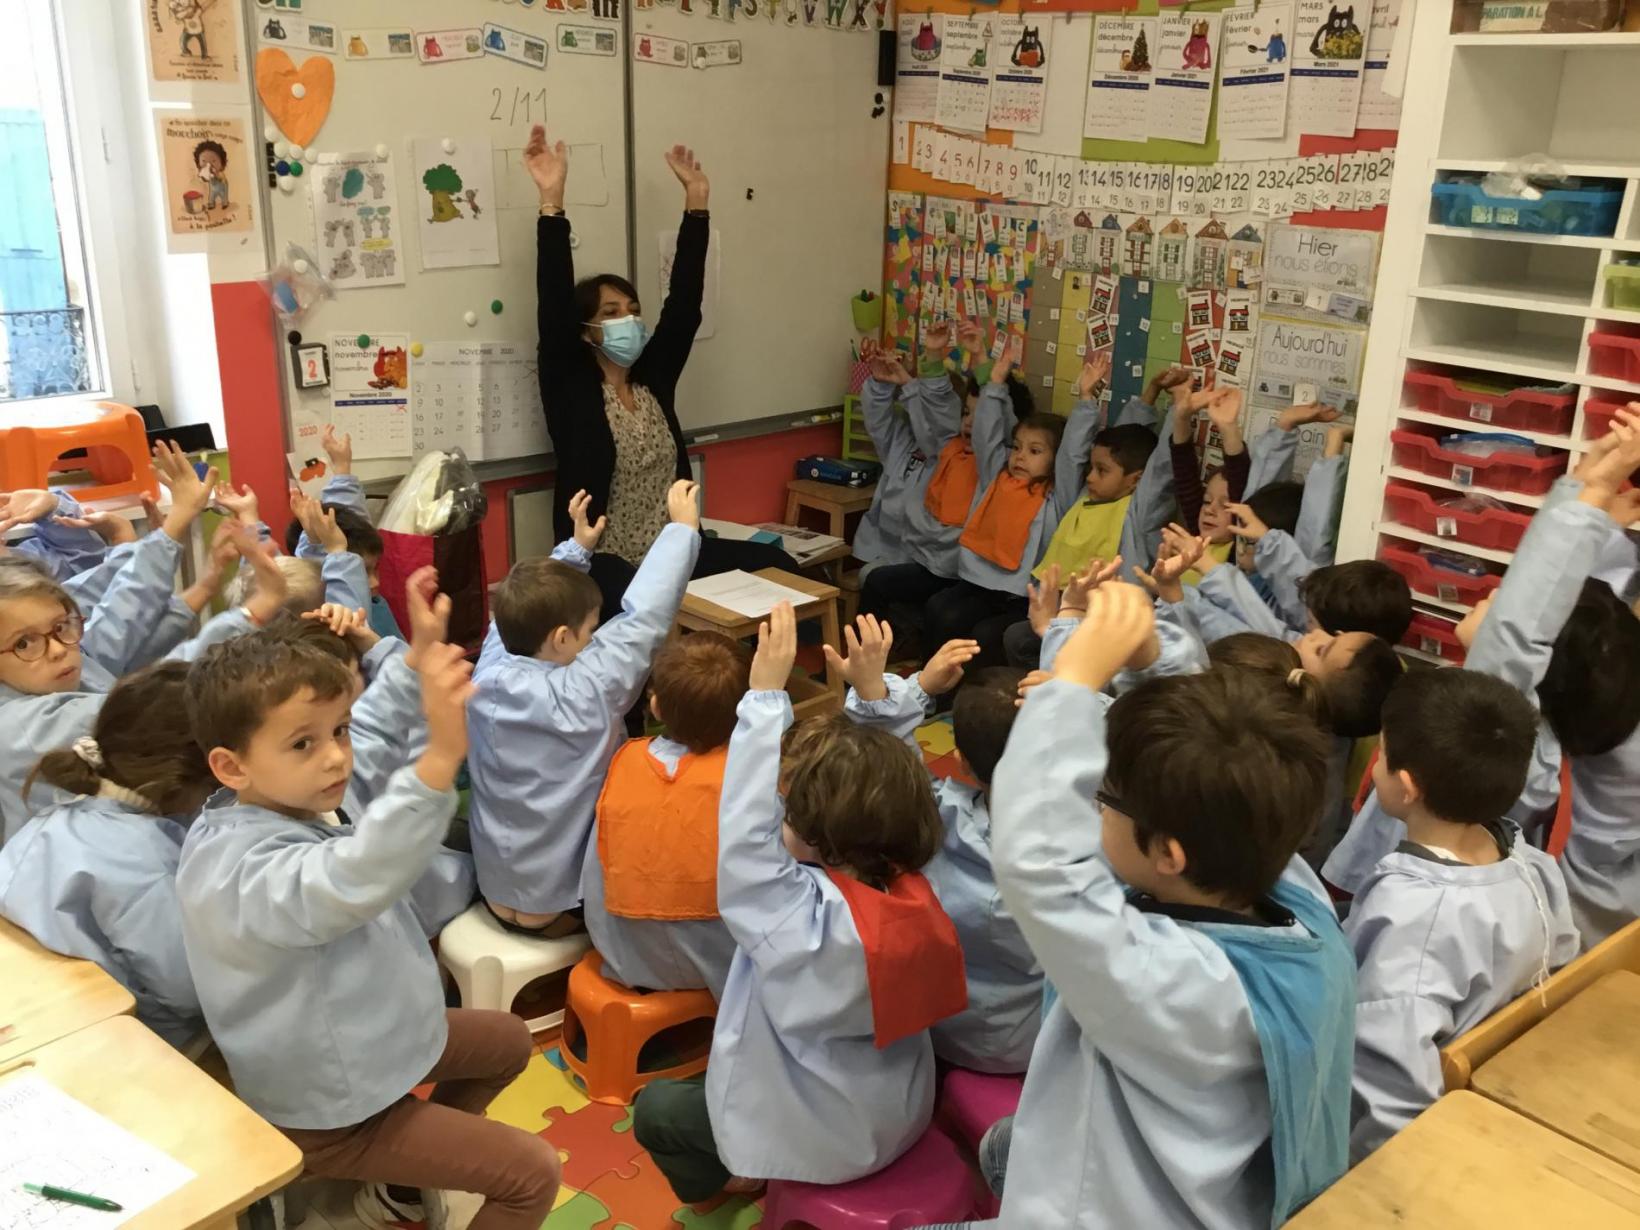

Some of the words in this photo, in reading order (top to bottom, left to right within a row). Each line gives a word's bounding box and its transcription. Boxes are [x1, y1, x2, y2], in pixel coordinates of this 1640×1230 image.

[1300, 2, 1324, 10] MARS
[1372, 4, 1390, 14] vril
[1099, 21, 1135, 30] DÉCEMBRE
[1098, 33, 1134, 41] décembre
[490, 86, 547, 126] 2/11
[1025, 159, 1038, 175] 10
[1038, 171, 1051, 187] 11
[1056, 173, 1072, 189] 12
[1091, 170, 1106, 187] 14
[1109, 170, 1124, 188] 15
[1143, 173, 1158, 190] 17
[1176, 175, 1194, 193] 19
[1197, 175, 1213, 193] 20
[1213, 172, 1230, 190] 21
[1231, 172, 1250, 191] 22
[1256, 170, 1276, 188] 23
[1276, 170, 1295, 189] 24
[1296, 166, 1316, 185] 25
[1317, 163, 1335, 183] 26
[1340, 163, 1362, 182] 27
[1294, 191, 1307, 205] 25
[1357, 190, 1372, 203] 28
[1298, 233, 1338, 257] Hier
[1274, 255, 1309, 272] nous
[335, 338, 380, 347] NOVERE
[1272, 326, 1348, 358] Aujourd'hui
[335, 351, 378, 359] novembre
[1264, 350, 1288, 366] nous
[1295, 355, 1346, 376] sommes
[307, 359, 318, 379] 2
